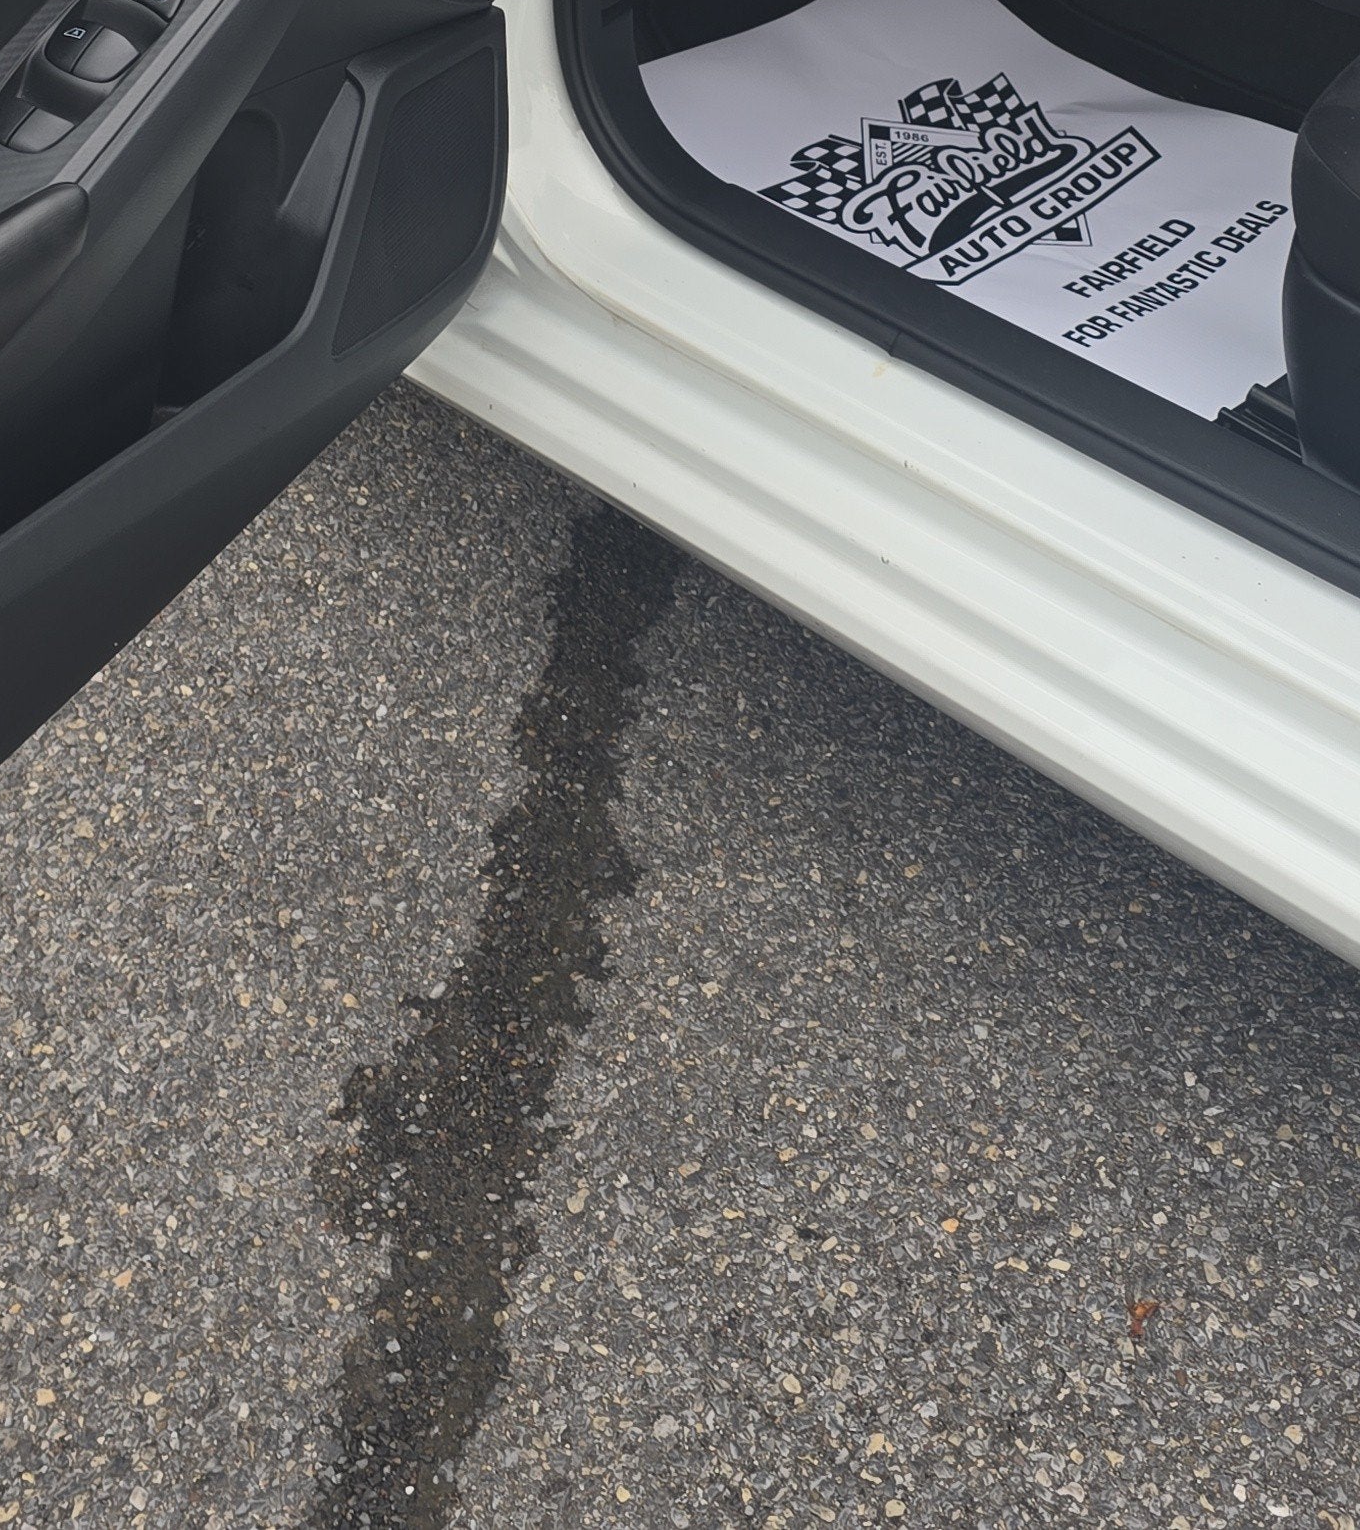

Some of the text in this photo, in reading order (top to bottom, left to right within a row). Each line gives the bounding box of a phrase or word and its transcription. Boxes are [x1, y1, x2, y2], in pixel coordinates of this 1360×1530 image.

[851, 115, 1052, 249] Fairfield
[875, 142, 888, 166] EST.
[894, 130, 930, 143] 1986
[938, 141, 1138, 278] AUTO GROUP
[1062, 218, 1196, 299] FAIRFIELD
[1061, 199, 1289, 348] FOR FANTASTIC DEALS
